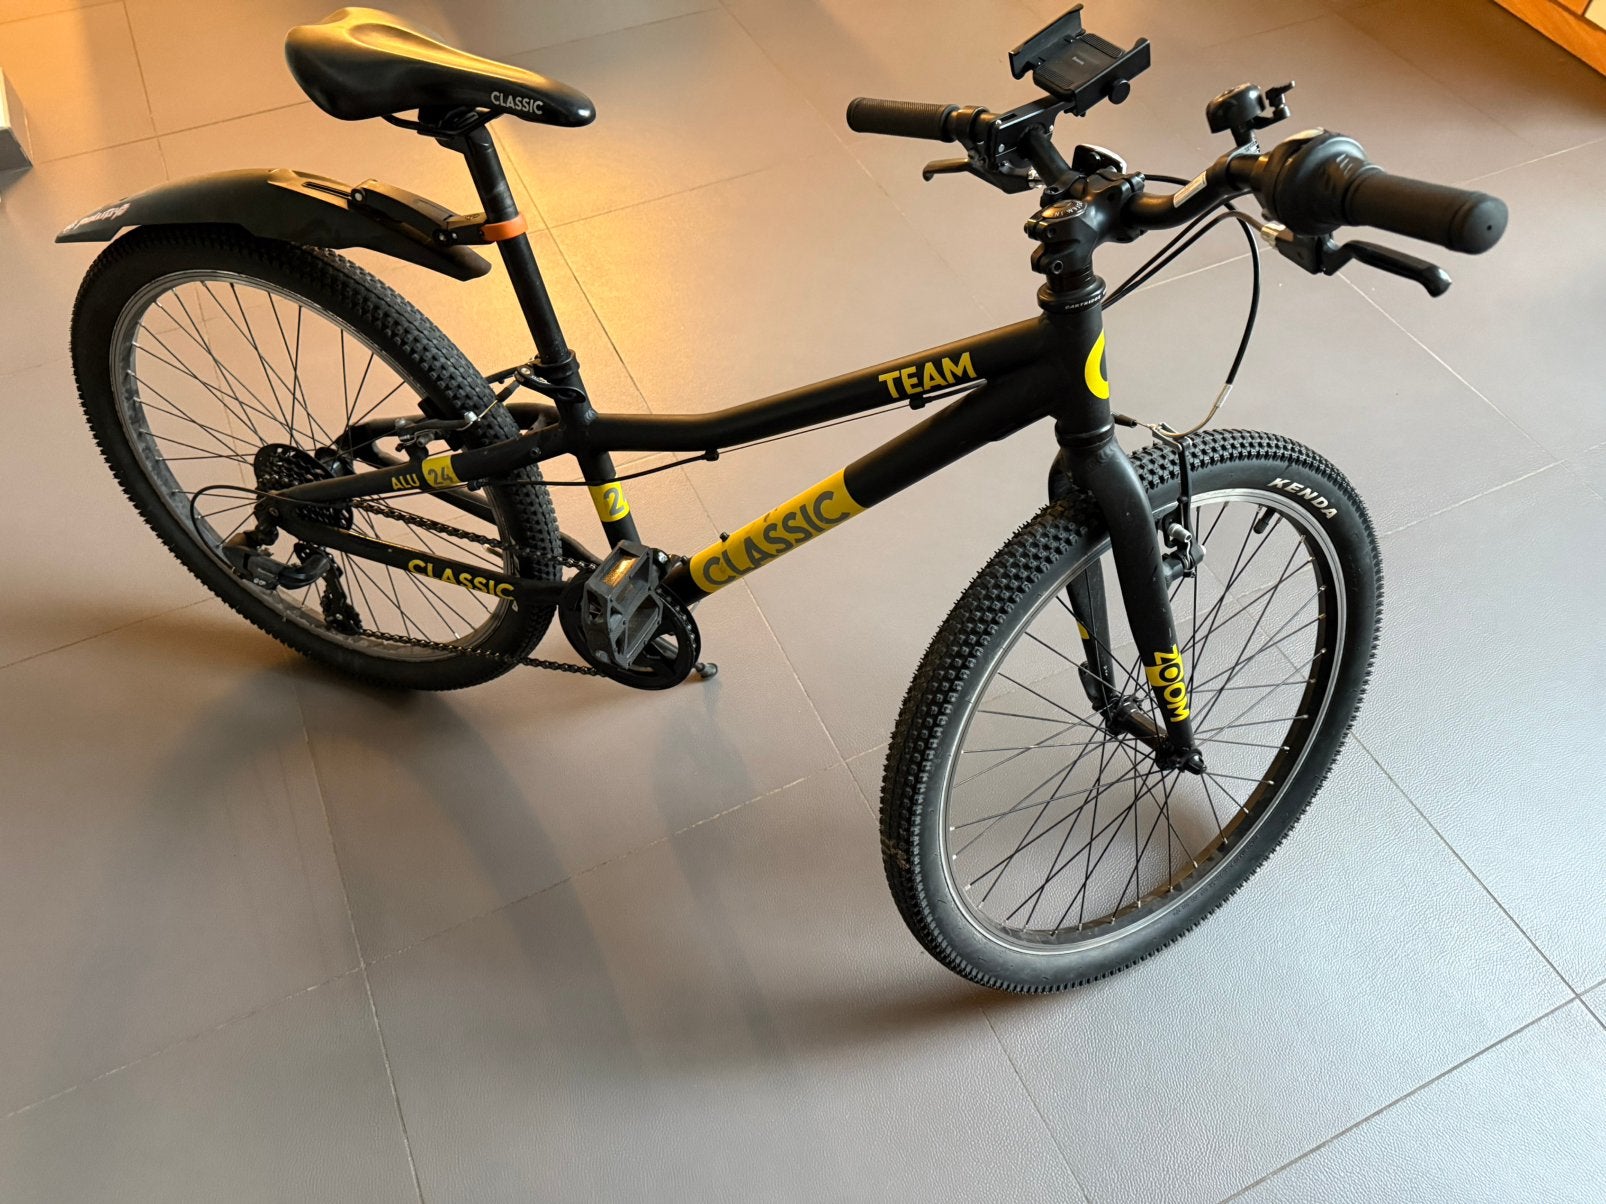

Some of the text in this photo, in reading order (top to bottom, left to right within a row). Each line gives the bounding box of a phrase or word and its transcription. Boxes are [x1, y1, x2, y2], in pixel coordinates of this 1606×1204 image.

[490, 91, 544, 115] CLASSIC
[878, 352, 978, 399] TEAM
[391, 466, 454, 490] ALU 24
[1266, 477, 1338, 520] KENDA
[603, 487, 625, 516] 2
[702, 490, 851, 586] CLASSIC
[407, 559, 515, 600] CLASSIC
[1154, 643, 1190, 723] ZOOM
